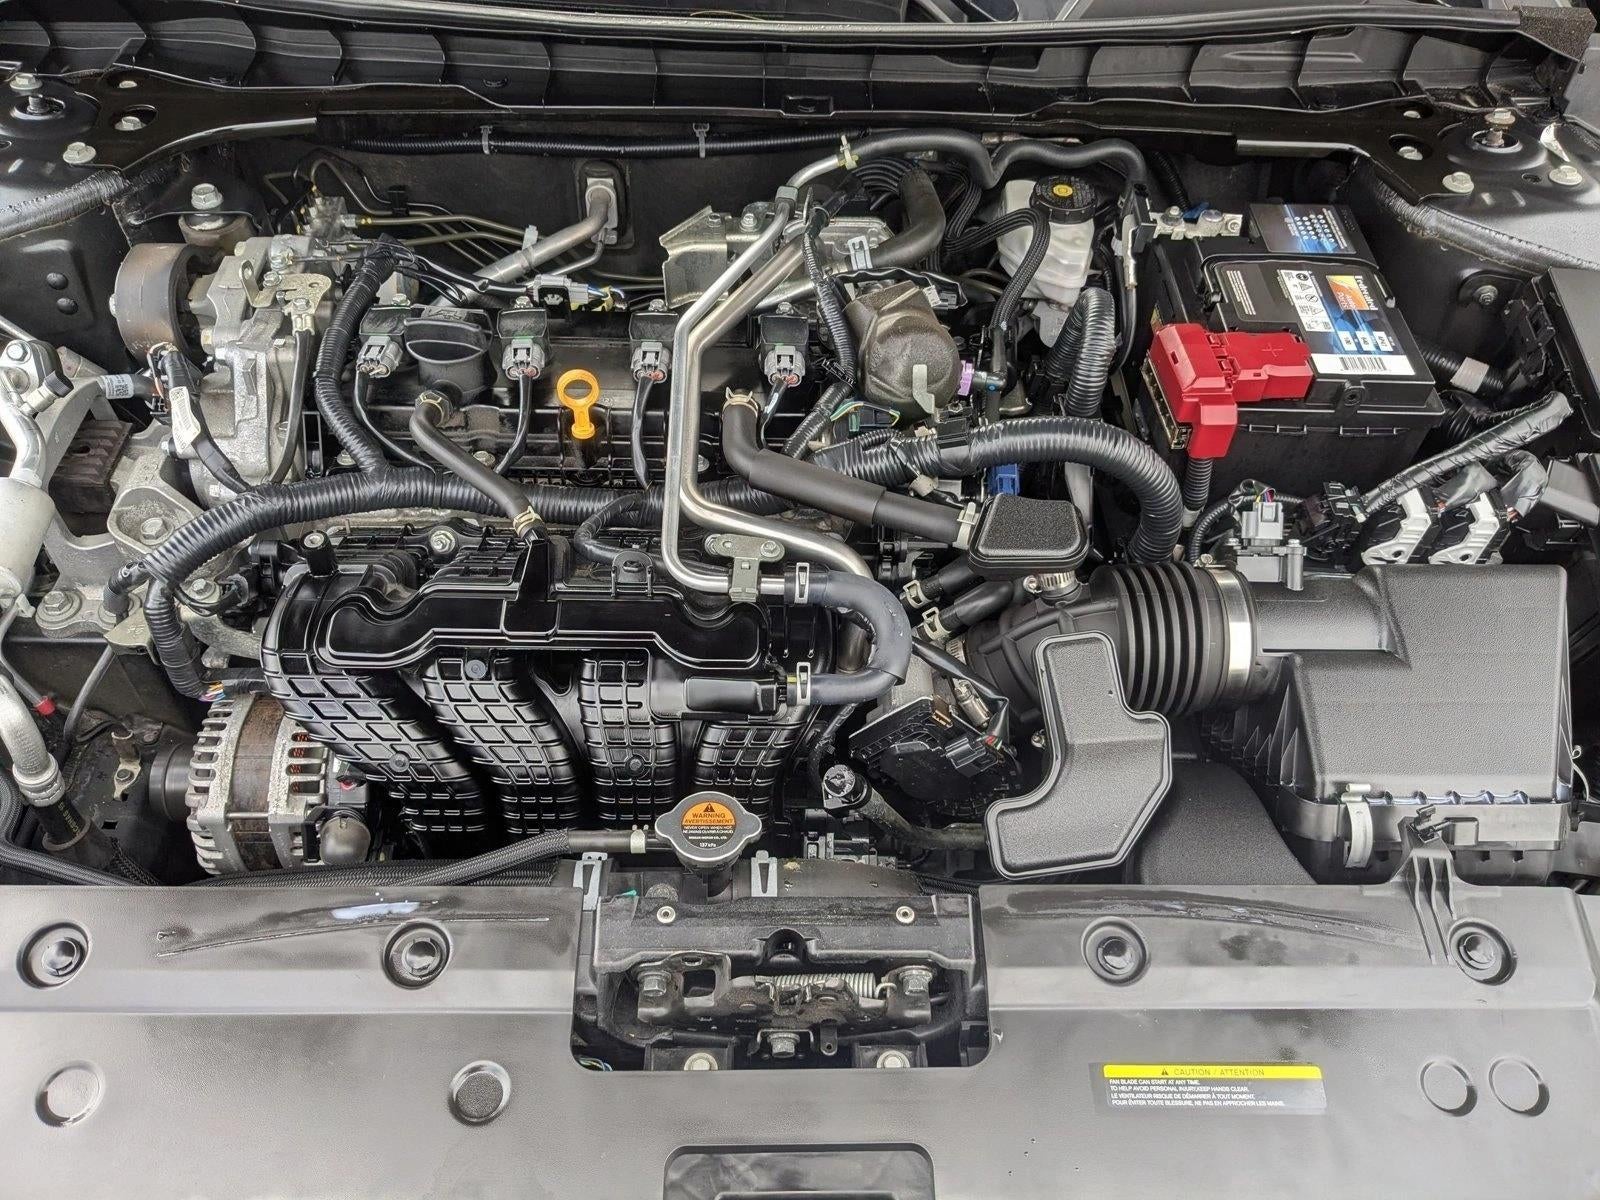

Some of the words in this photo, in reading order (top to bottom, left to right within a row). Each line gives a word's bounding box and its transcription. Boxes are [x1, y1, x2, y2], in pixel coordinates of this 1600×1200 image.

[1354, 275, 1379, 311] Federated
[1173, 1068, 1211, 1077] CAUTION
[1219, 1068, 1265, 1077] ATTENTION
